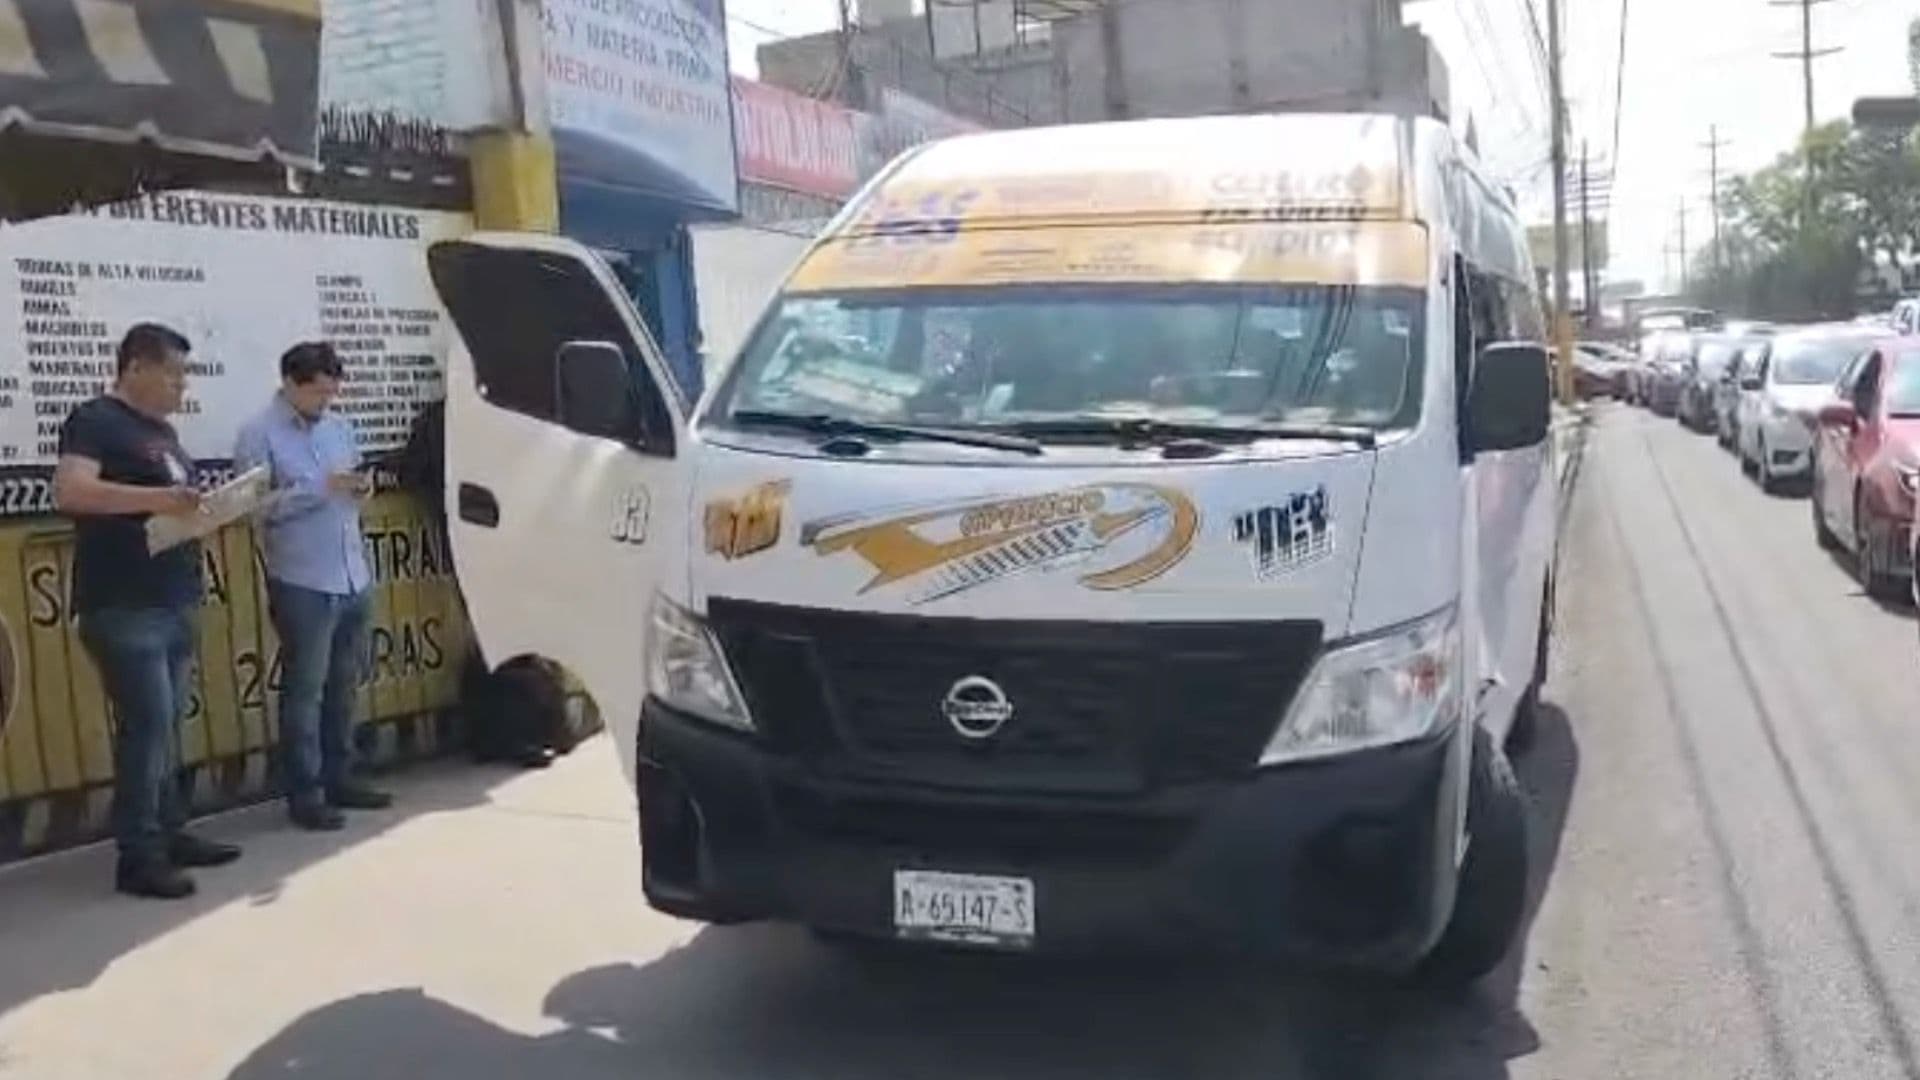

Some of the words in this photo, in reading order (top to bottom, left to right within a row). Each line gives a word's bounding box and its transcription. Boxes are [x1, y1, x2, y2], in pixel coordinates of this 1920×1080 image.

[545, 52, 624, 96] MERCIO
[273, 206, 420, 240] MATERIALES
[371, 617, 444, 682] RAS
[902, 888, 1028, 928] A-65147-S
